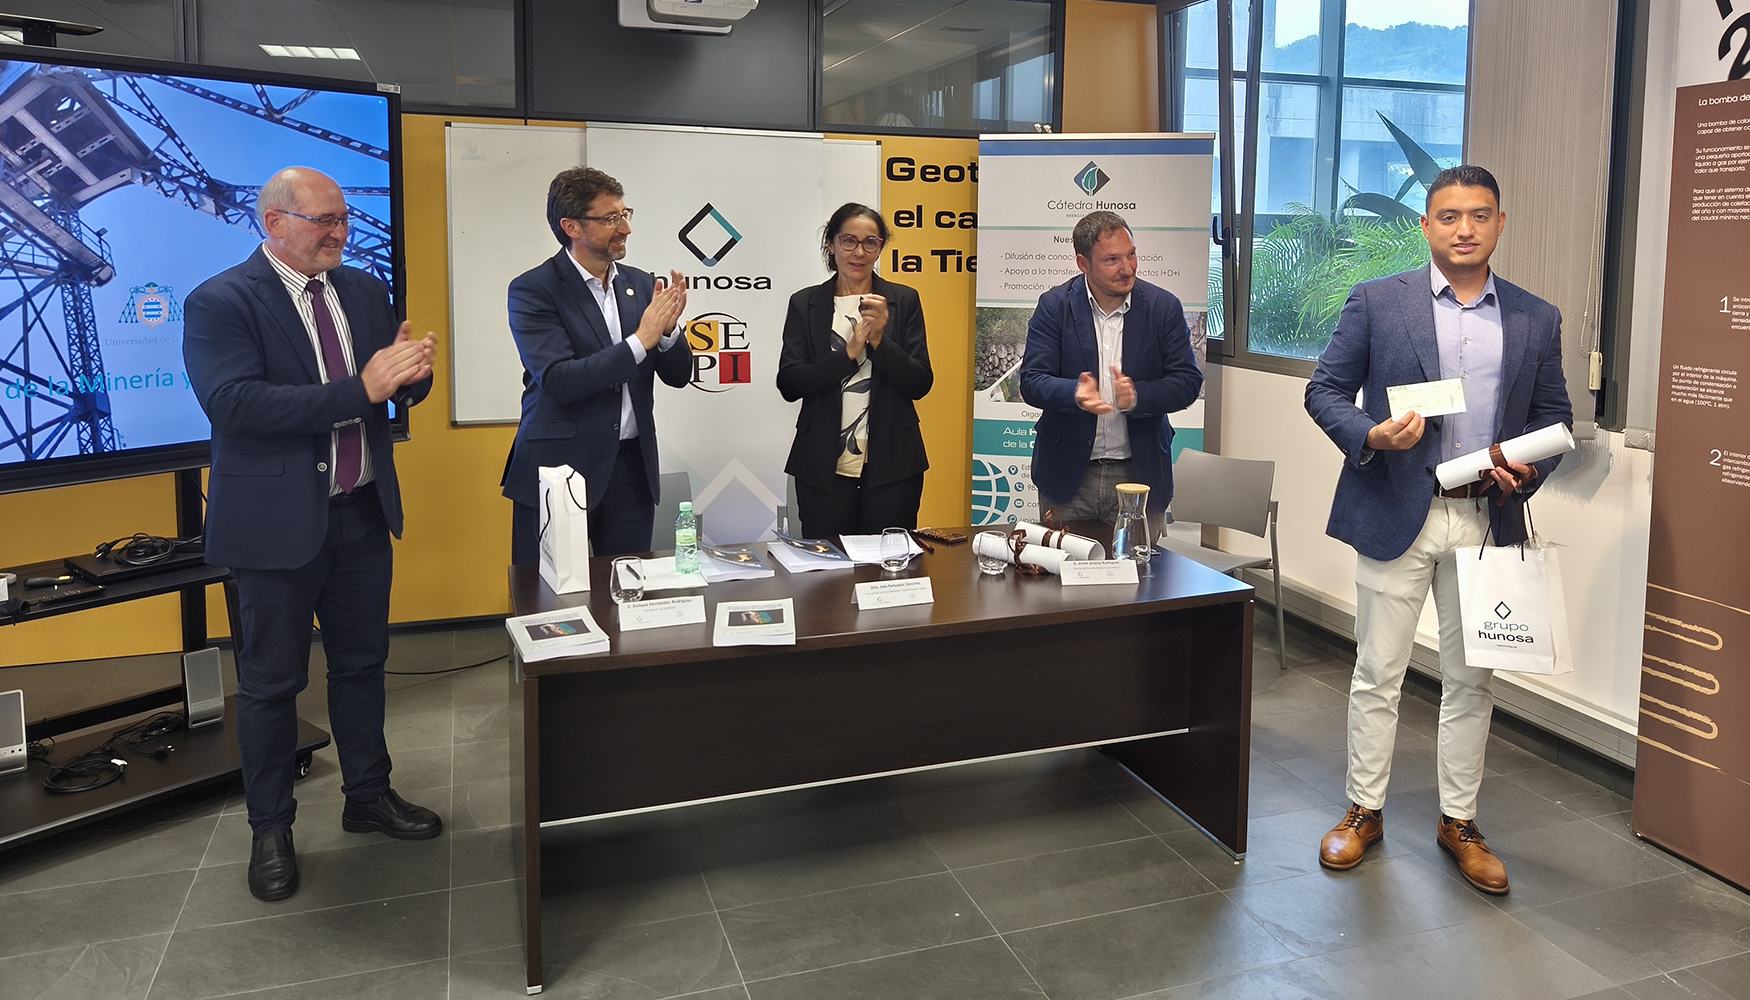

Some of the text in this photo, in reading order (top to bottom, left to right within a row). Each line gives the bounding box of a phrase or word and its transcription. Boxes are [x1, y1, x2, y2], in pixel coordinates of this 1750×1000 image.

[1709, 95, 1738, 105] bomba
[1047, 200, 1136, 210] Cátedra Hunosa
[894, 205, 978, 229] el ca
[892, 249, 922, 273] la
[1005, 252, 1034, 260] Difusión
[1004, 267, 1030, 276] Apoyo
[1160, 269, 1181, 277] I+D+i
[650, 272, 772, 290] hnosa
[1004, 282, 1044, 290] Promoción
[1719, 296, 1731, 314] 1
[105, 333, 158, 346] Universidad
[159, 335, 170, 343] de
[689, 321, 751, 352] SE
[692, 353, 744, 383] PI
[1693, 366, 1720, 374] refrigerante
[5, 378, 38, 400] de
[48, 375, 69, 396] la
[79, 367, 174, 394] Minería
[1715, 375, 1738, 383] máquina.
[1699, 380, 1732, 389] condensación
[1698, 393, 1722, 401] fácilmente
[1002, 427, 1027, 436] Aula
[1002, 439, 1017, 448] de
[1018, 440, 1028, 449] la
[1709, 448, 1722, 466] 2
[1484, 621, 1529, 632] grupo
[1478, 630, 1534, 644] hunosa
